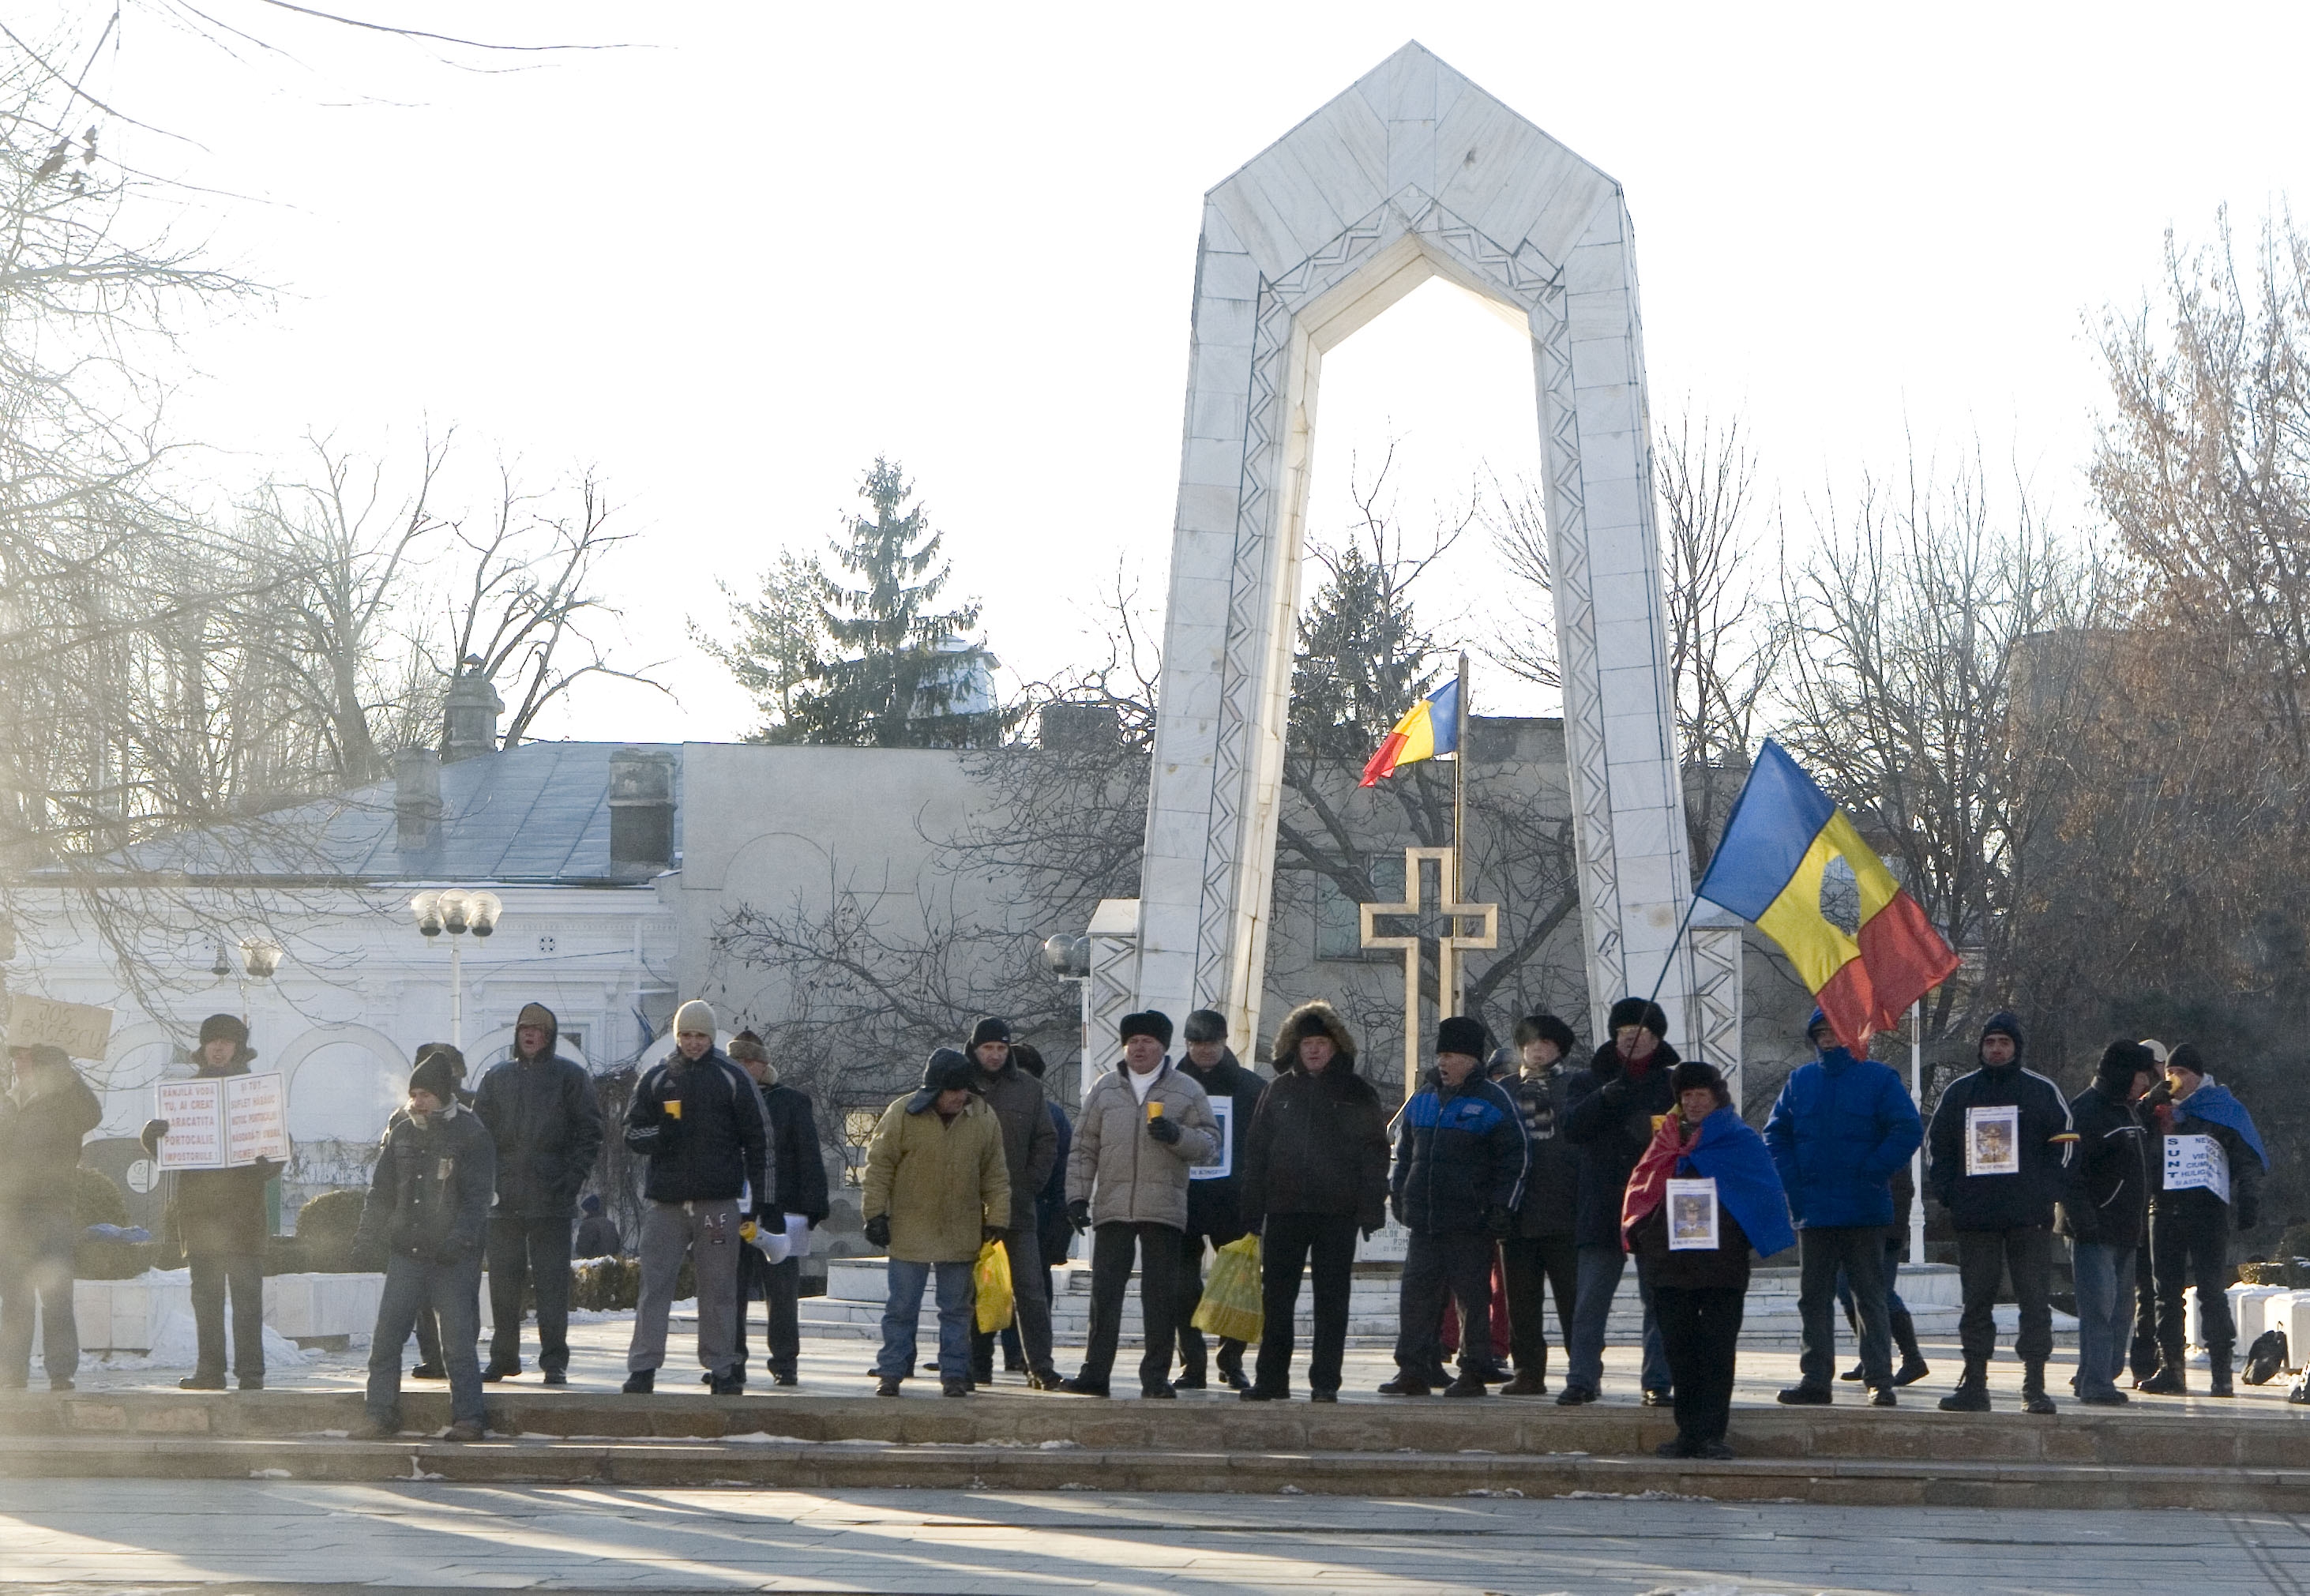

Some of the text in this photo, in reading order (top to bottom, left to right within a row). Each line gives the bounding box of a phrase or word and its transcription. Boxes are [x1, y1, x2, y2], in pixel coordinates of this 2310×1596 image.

[39, 1002, 76, 1026] JOS
[180, 1100, 188, 1110] AI
[190, 1099, 214, 1110] CREAT
